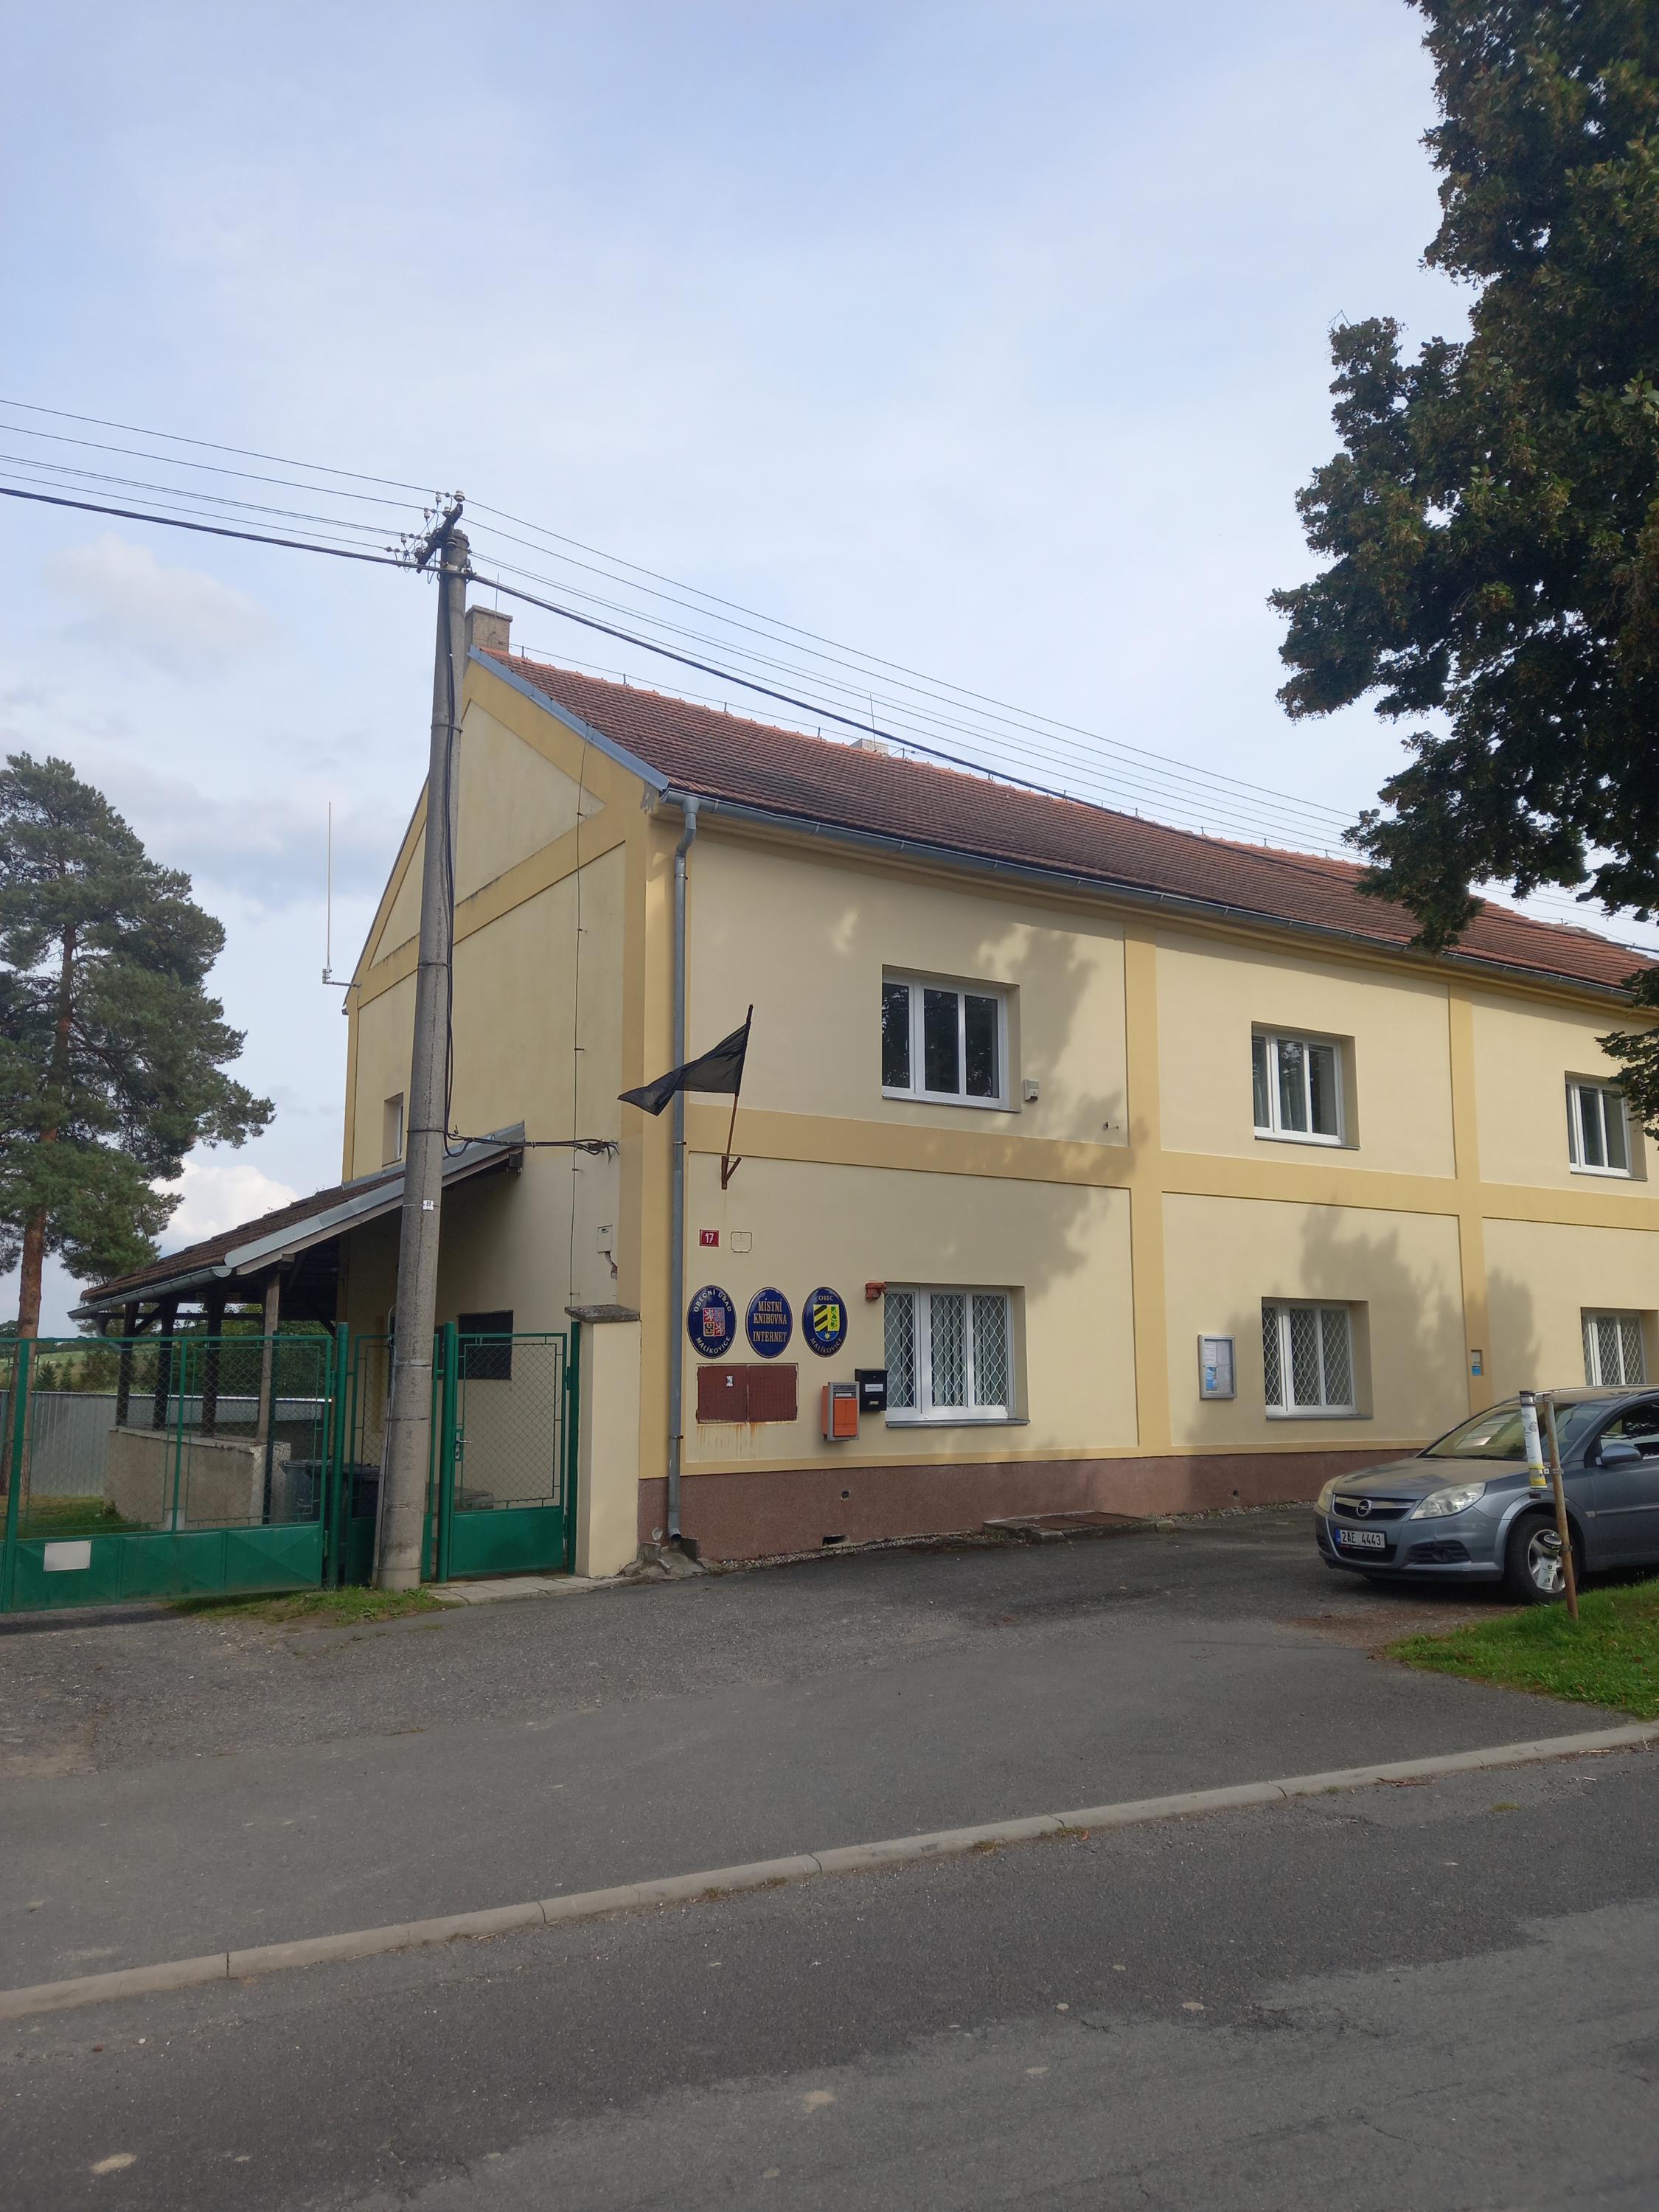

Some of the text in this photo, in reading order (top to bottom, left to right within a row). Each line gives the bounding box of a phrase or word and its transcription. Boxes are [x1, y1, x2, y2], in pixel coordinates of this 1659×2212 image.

[705, 1233, 714, 1243] 17
[694, 1288, 715, 1312] OBECNÍ
[758, 1298, 782, 1312] MÍSTNÍ
[754, 1313, 787, 1324] KNIHOVNA
[753, 1332, 787, 1342] INTERNET
[695, 1335, 731, 1354] MALÍKOVICE
[1342, 1531, 1381, 1545] 2AE 4443
